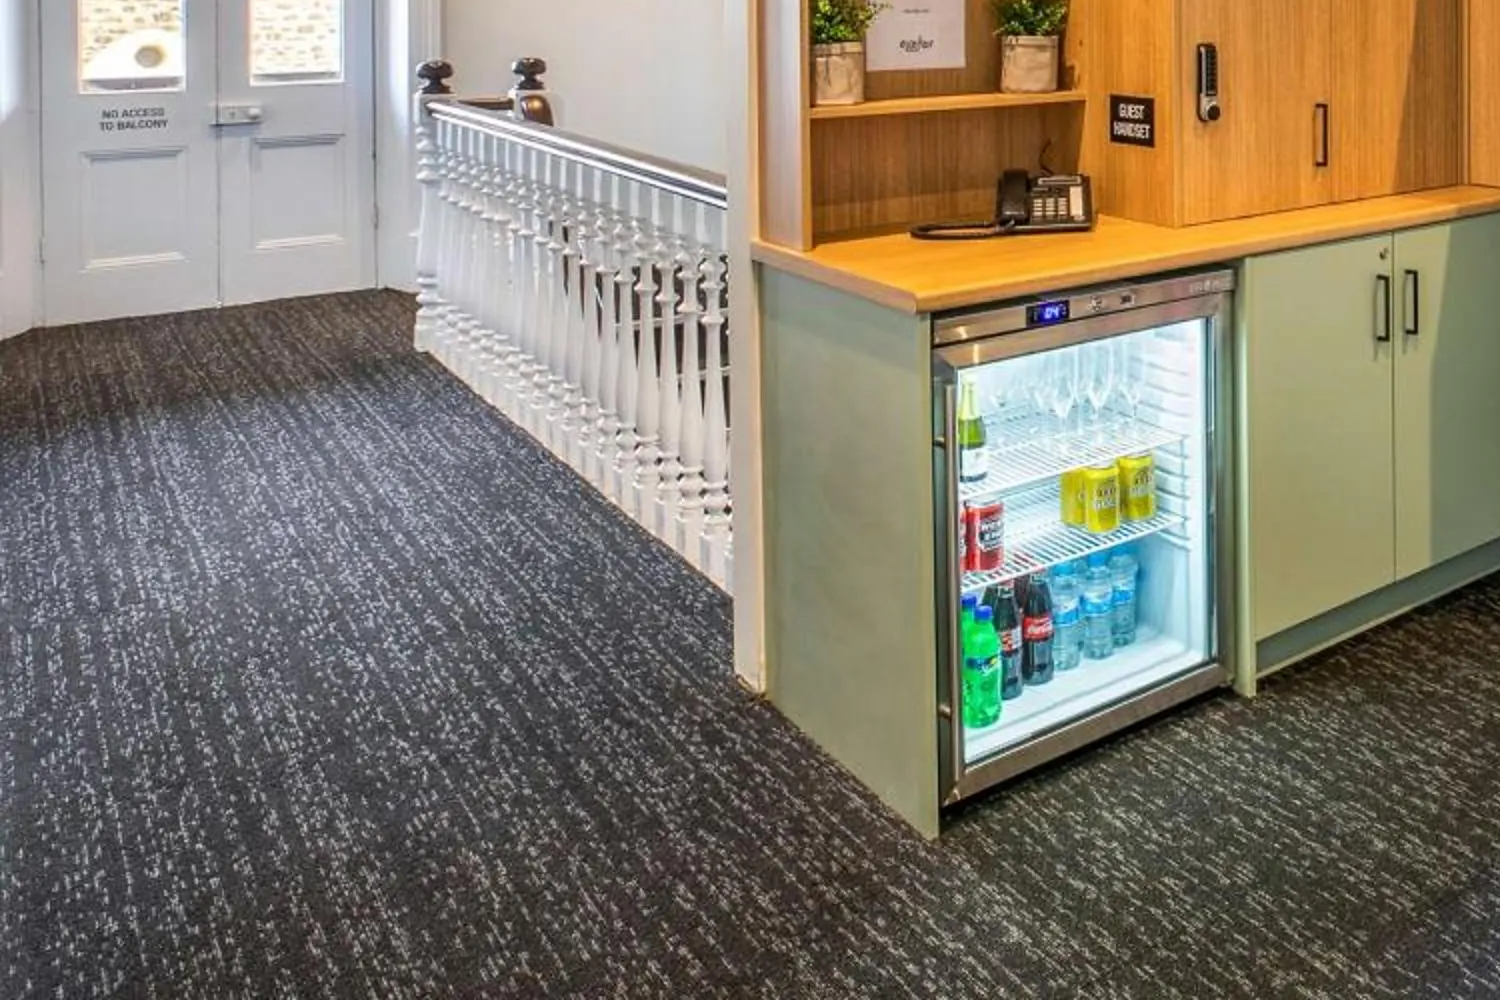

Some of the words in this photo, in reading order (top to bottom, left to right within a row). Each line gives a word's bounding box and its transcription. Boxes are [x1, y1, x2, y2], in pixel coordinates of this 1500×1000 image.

[101, 109, 118, 119] NO
[122, 107, 165, 118] ACCESS
[99, 121, 114, 132] TO
[117, 119, 168, 131] BALCONY
